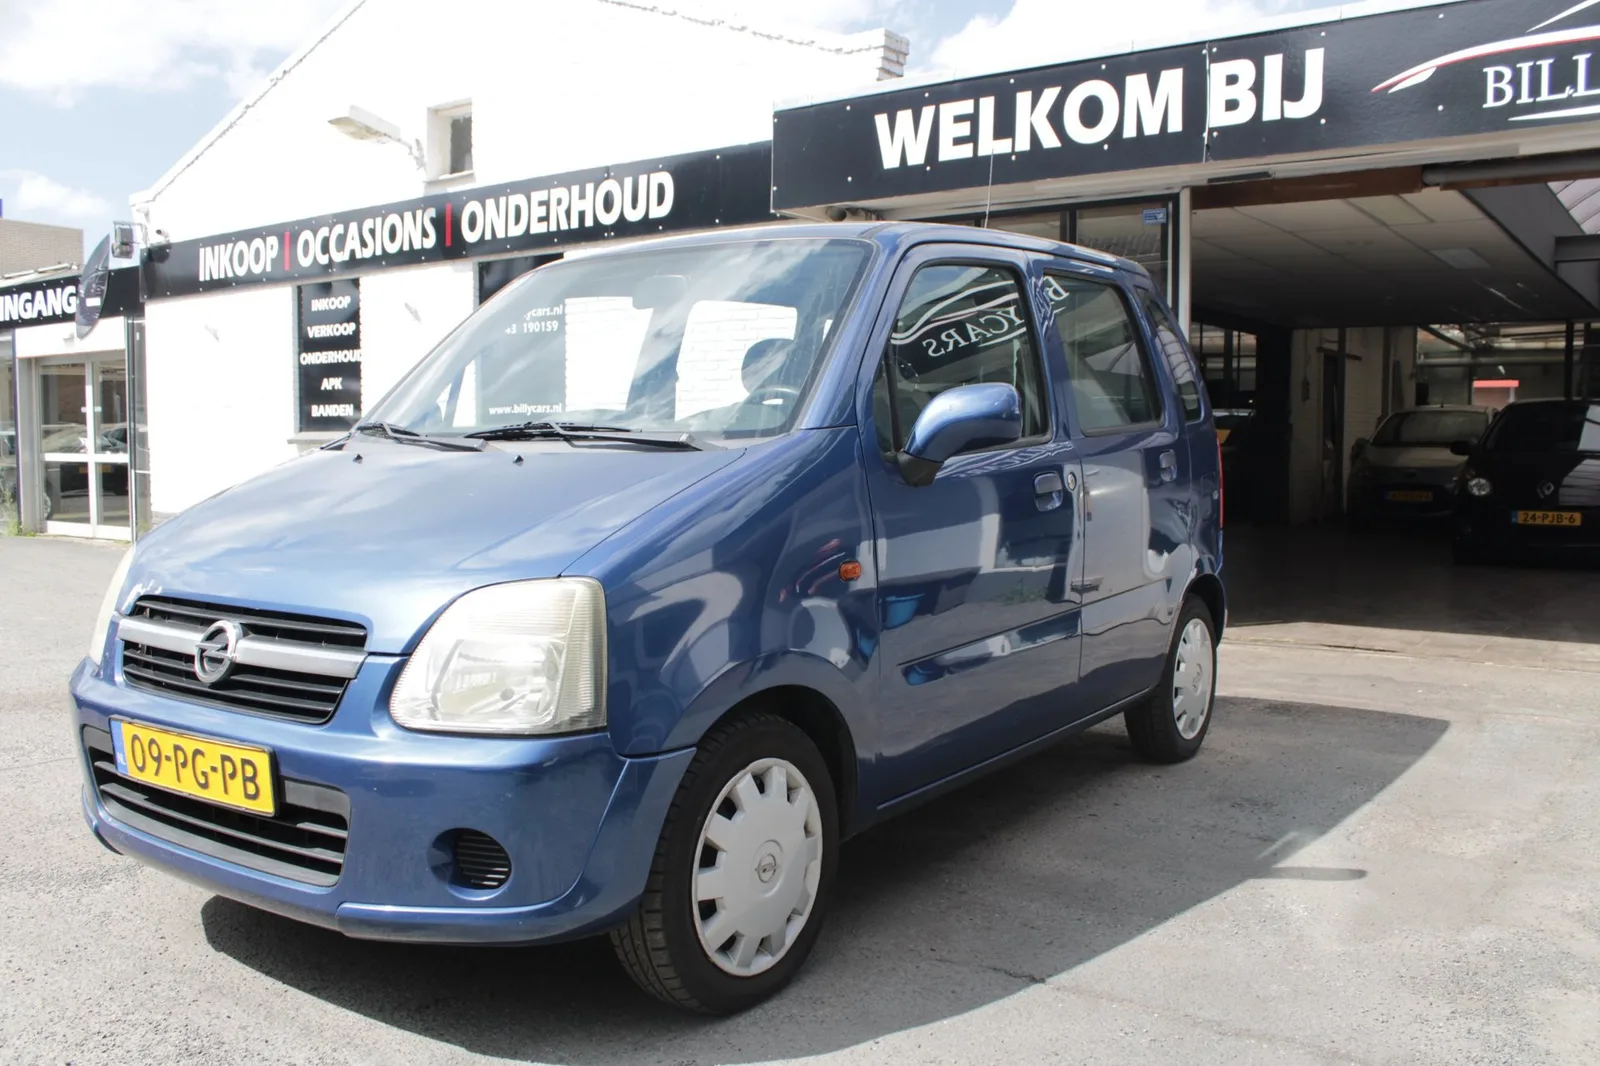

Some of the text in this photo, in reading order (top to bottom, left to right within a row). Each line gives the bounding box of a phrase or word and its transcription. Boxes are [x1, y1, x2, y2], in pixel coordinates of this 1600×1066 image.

[874, 47, 1325, 170] WELKOM BIJ
[199, 171, 675, 282] INKOOP OCCASIONS ONDERHOUD
[311, 296, 351, 311] INKOOP
[307, 322, 356, 338] VERKOOP
[523, 320, 559, 333] 190159
[300, 349, 363, 365] ONDERHOUD
[320, 377, 343, 390] APK
[311, 404, 354, 417] BANDEN
[488, 403, 562, 415] www.billycars.nl
[1522, 512, 1576, 524] 24-PJB-6
[131, 733, 261, 801] 09-PG-PB
